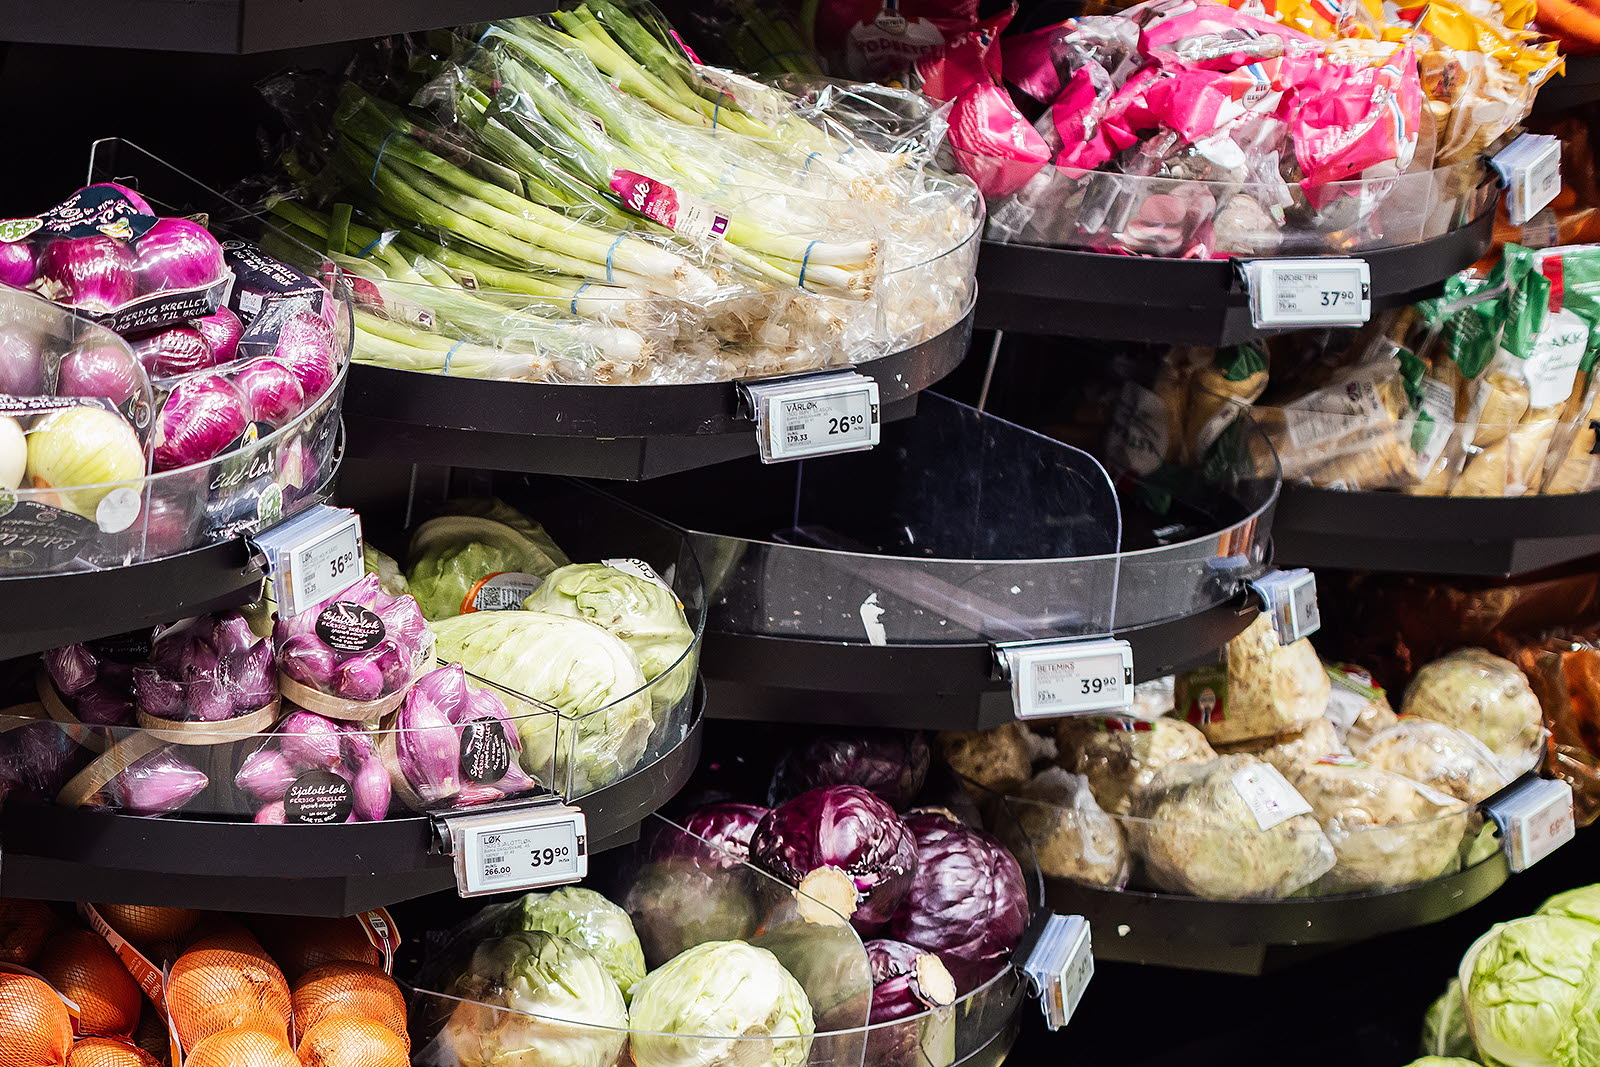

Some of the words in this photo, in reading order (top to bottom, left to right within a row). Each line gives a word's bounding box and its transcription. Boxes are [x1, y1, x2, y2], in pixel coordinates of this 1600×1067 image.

[628, 182, 650, 211] løk
[1320, 290, 1355, 306] 3790
[116, 322, 132, 333] OG
[134, 315, 159, 328] KLAR
[162, 311, 179, 321] TIL
[182, 305, 209, 319] BRUK
[120, 306, 158, 323] FERDIG
[160, 298, 208, 314] SKRELLET
[786, 402, 819, 413] VÅRLØK
[828, 414, 864, 435] 2690
[786, 434, 808, 443] 179.33
[330, 551, 353, 578] 3690
[1080, 676, 1117, 695] 3990
[483, 835, 502, 845] LØK
[530, 846, 569, 868] 3990
[484, 866, 511, 876] 266.00
